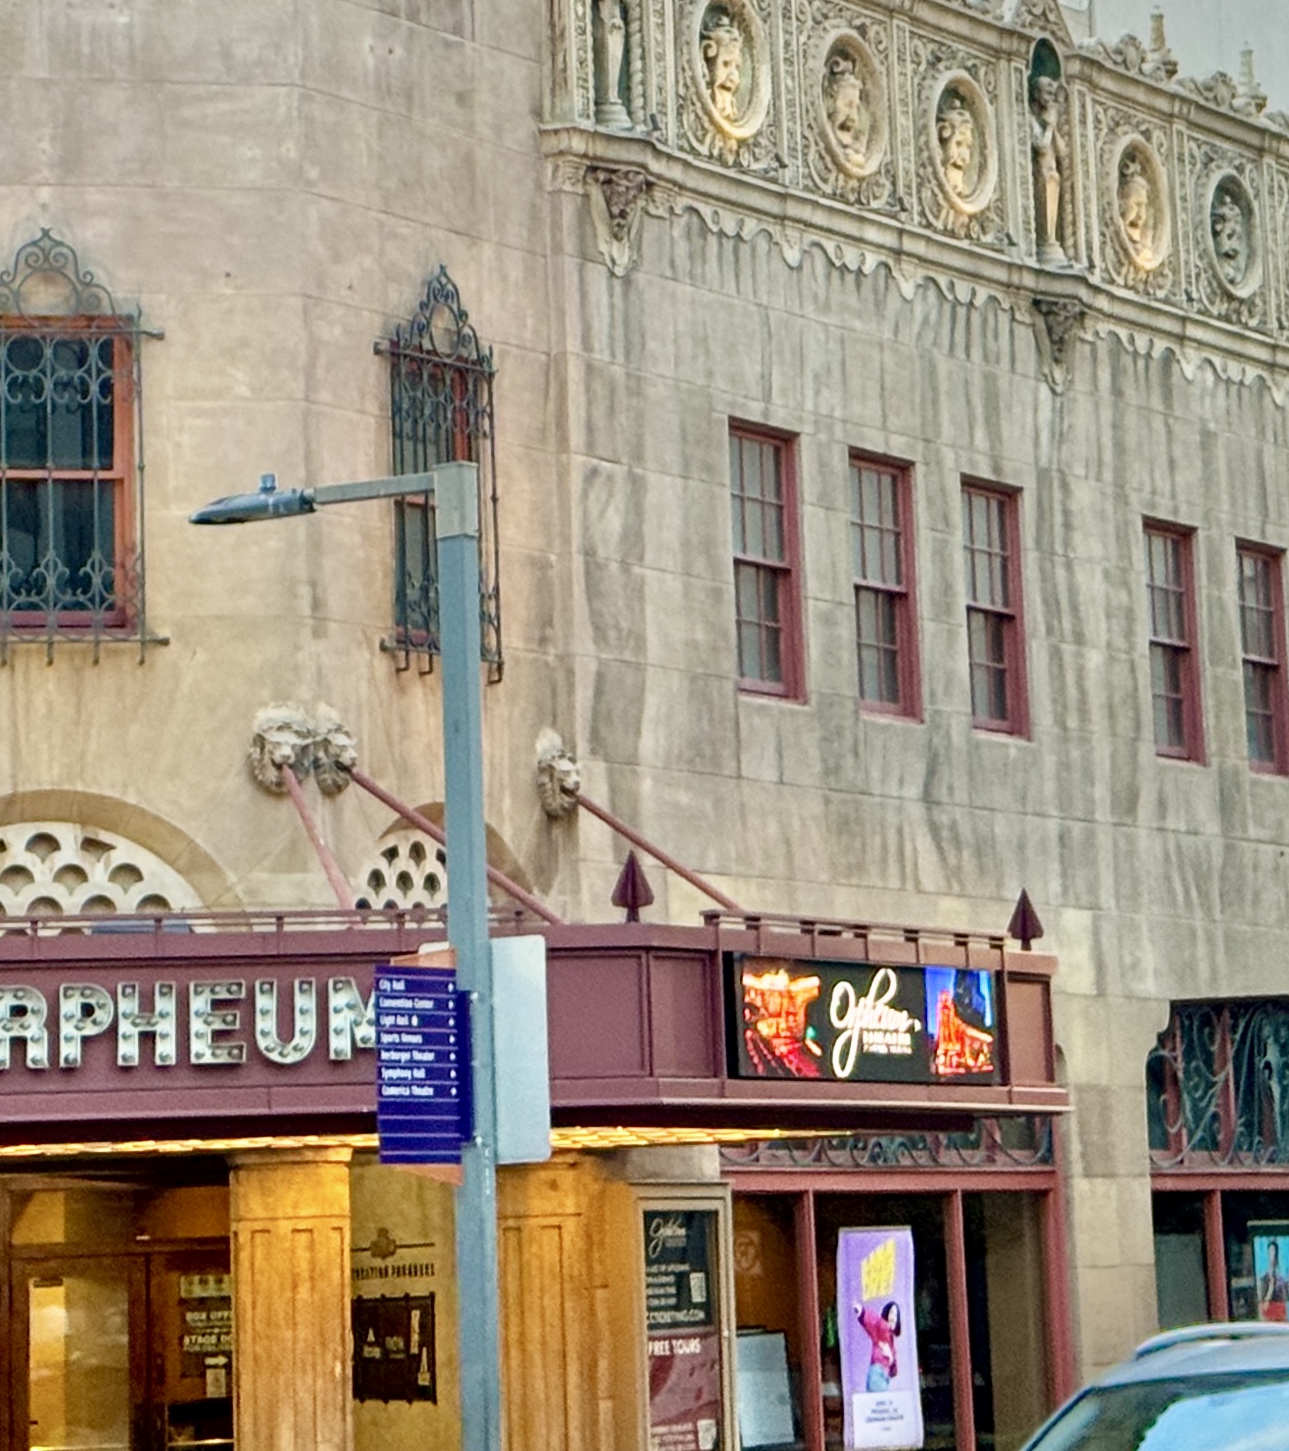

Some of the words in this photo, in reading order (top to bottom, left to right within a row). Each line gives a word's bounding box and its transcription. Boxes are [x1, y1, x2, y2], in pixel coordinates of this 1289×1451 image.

[380, 1014, 395, 1029] Light
[830, 967, 922, 1079] Orpheum
[671, 1337, 700, 1355] TOURS
